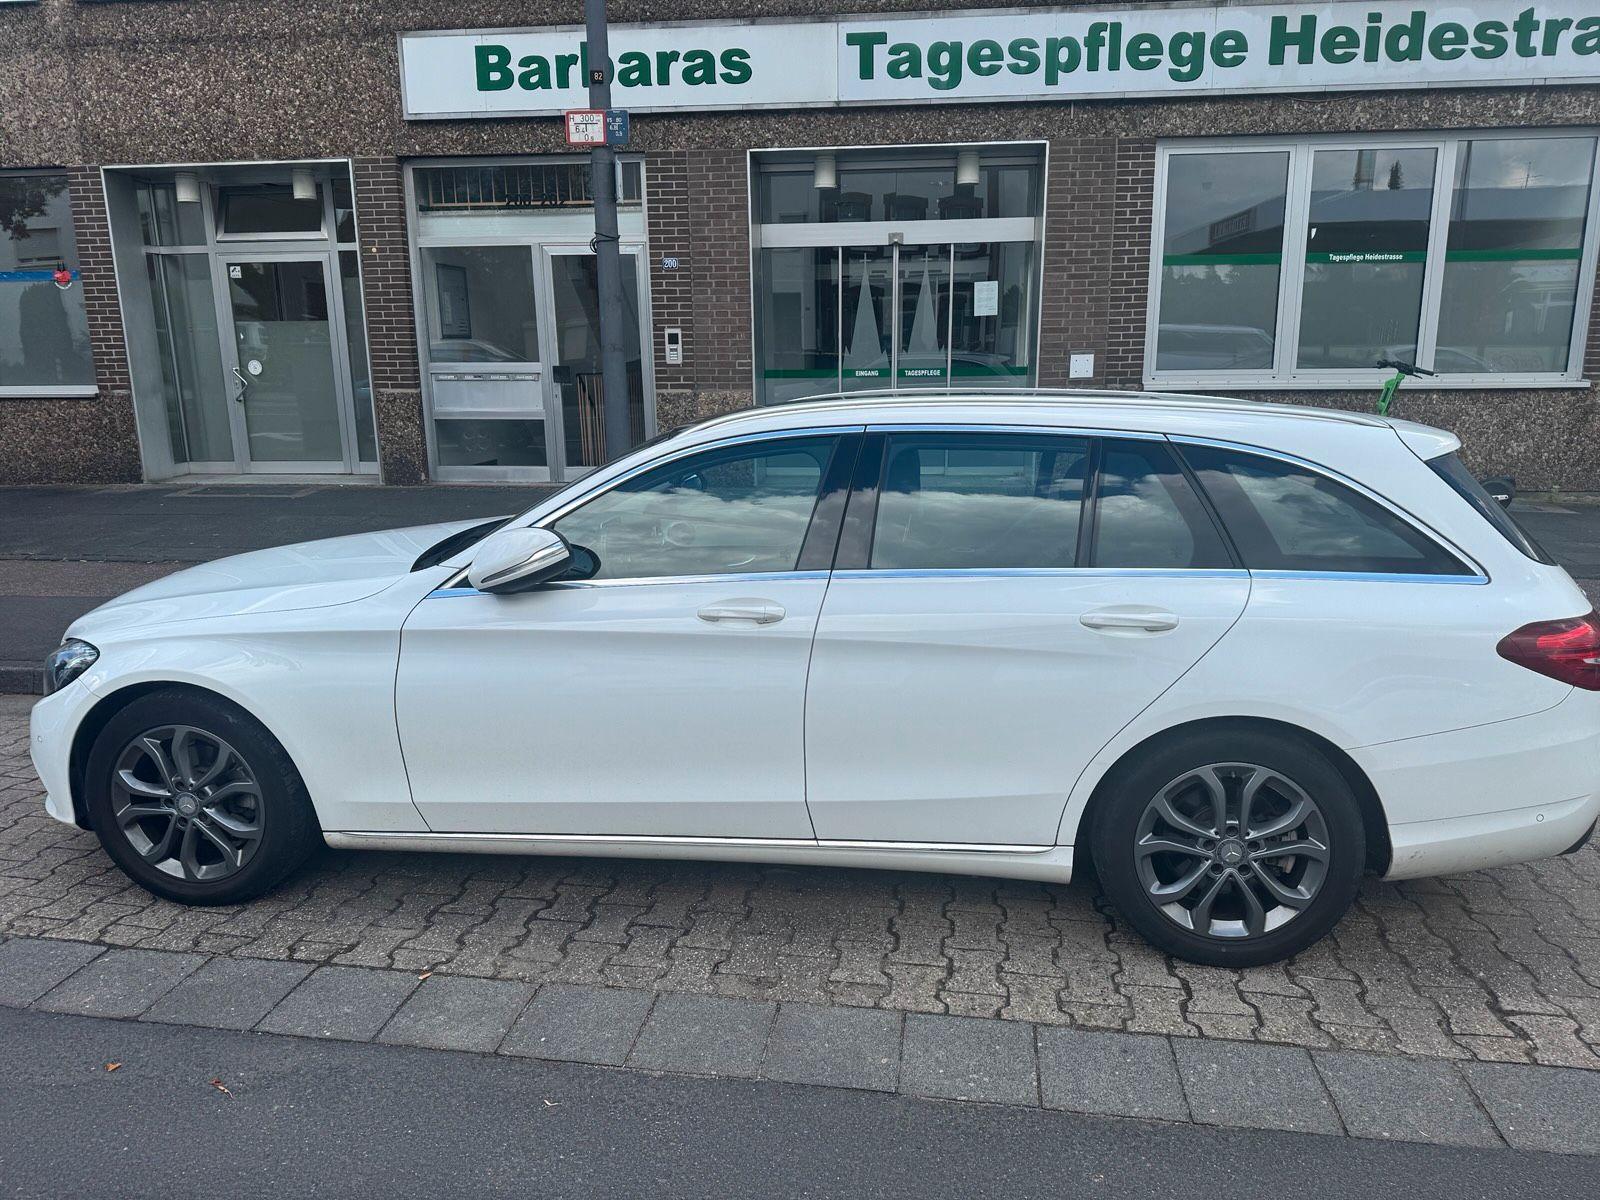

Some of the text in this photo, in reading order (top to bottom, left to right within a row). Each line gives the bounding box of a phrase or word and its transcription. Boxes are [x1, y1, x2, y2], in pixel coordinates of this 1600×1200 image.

[846, 22, 1248, 91] Tagespflege
[594, 72, 603, 81] 82
[580, 114, 595, 122] 300
[1329, 253, 1364, 262] Tagespflege
[664, 259, 677, 268] 200
